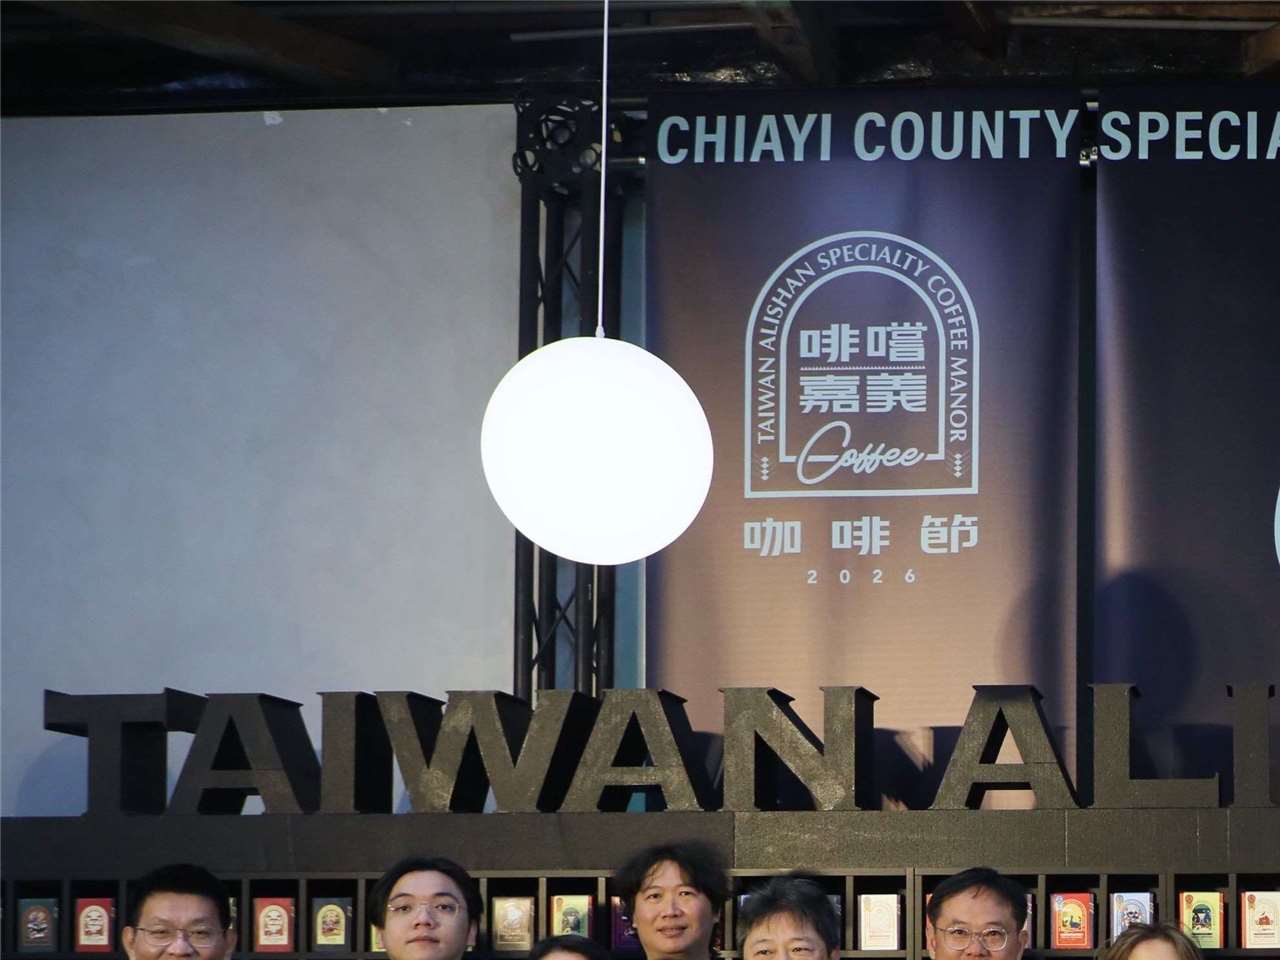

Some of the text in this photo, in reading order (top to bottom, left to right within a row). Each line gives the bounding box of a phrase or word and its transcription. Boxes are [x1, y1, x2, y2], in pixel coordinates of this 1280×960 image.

[657, 113, 832, 164] CHIAYI
[853, 108, 1079, 161] COUNTY
[757, 242, 969, 445] TAIWAN ALISHAN SPECIALTY COFFEE MANOR
[800, 321, 928, 363] 啡嚐
[800, 372, 928, 414] 嘉義
[797, 419, 925, 485] Coffee
[744, 514, 979, 557] 咖啡節
[43, 687, 880, 813] TAIWAN
